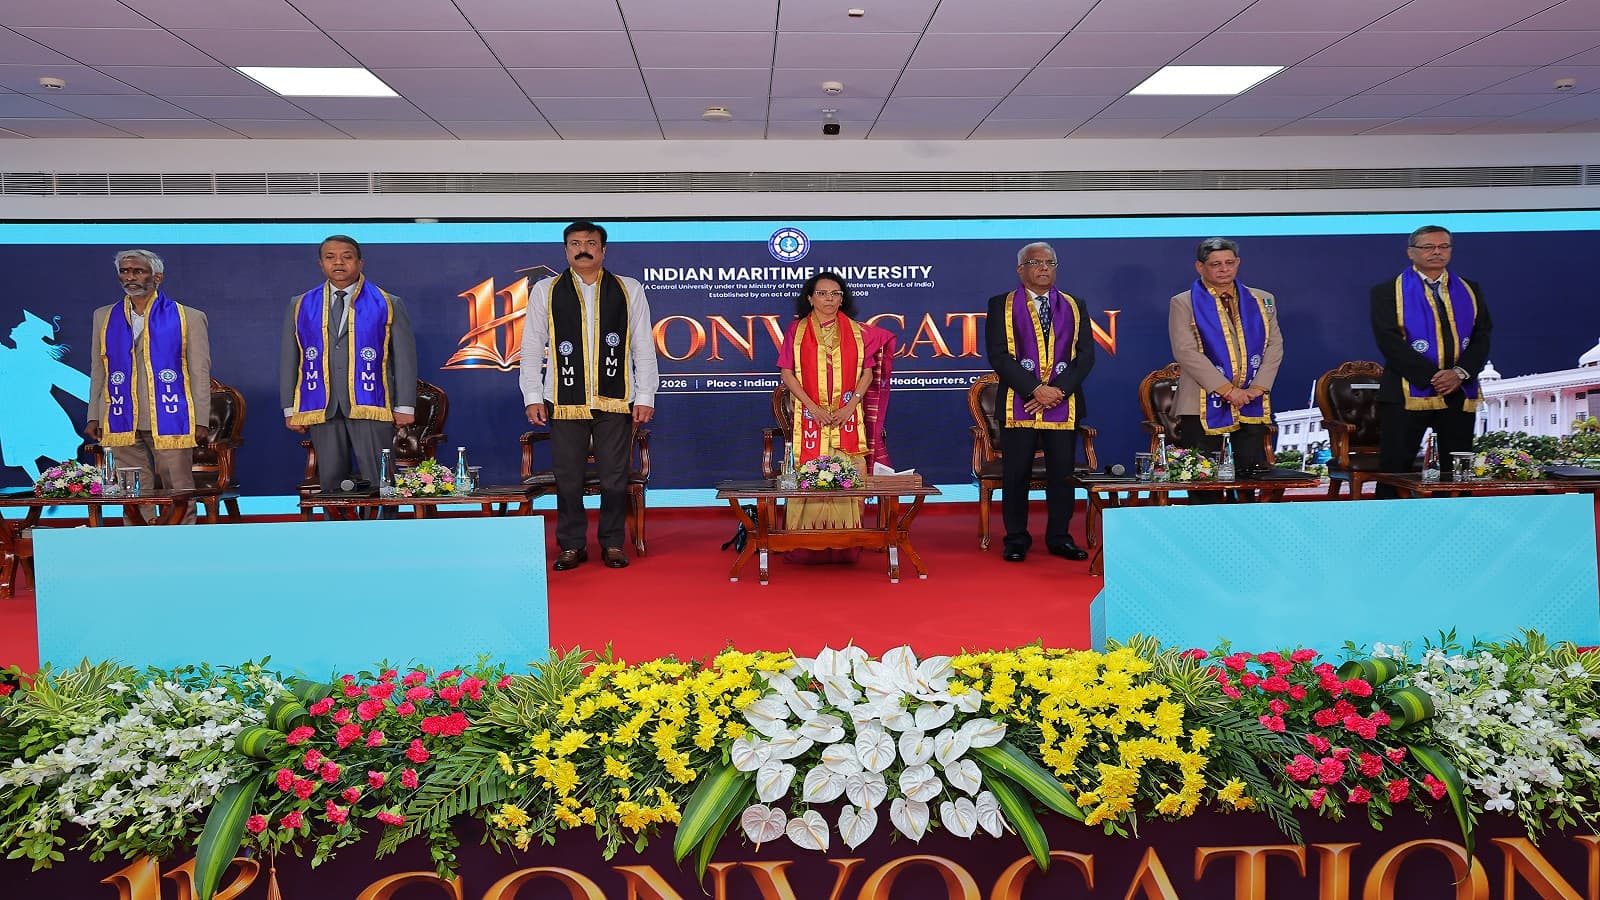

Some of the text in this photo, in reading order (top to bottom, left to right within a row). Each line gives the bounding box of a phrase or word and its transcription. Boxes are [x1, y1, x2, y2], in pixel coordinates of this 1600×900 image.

[644, 267, 713, 281] INDIAN
[718, 266, 814, 280] MARITIME
[678, 283, 713, 291] University
[914, 281, 935, 289] India)
[750, 291, 759, 299] by
[306, 361, 318, 391] IMU
[562, 356, 575, 386] IMU
[605, 347, 618, 377] IMU
[361, 362, 376, 392] IMU
[661, 379, 688, 388] 2026
[706, 379, 737, 388] Place
[743, 378, 779, 388] Indian
[890, 376, 967, 387] Headquarters,
[111, 386, 124, 416] IMU
[161, 384, 179, 413] IMU
[804, 420, 818, 449] IMU
